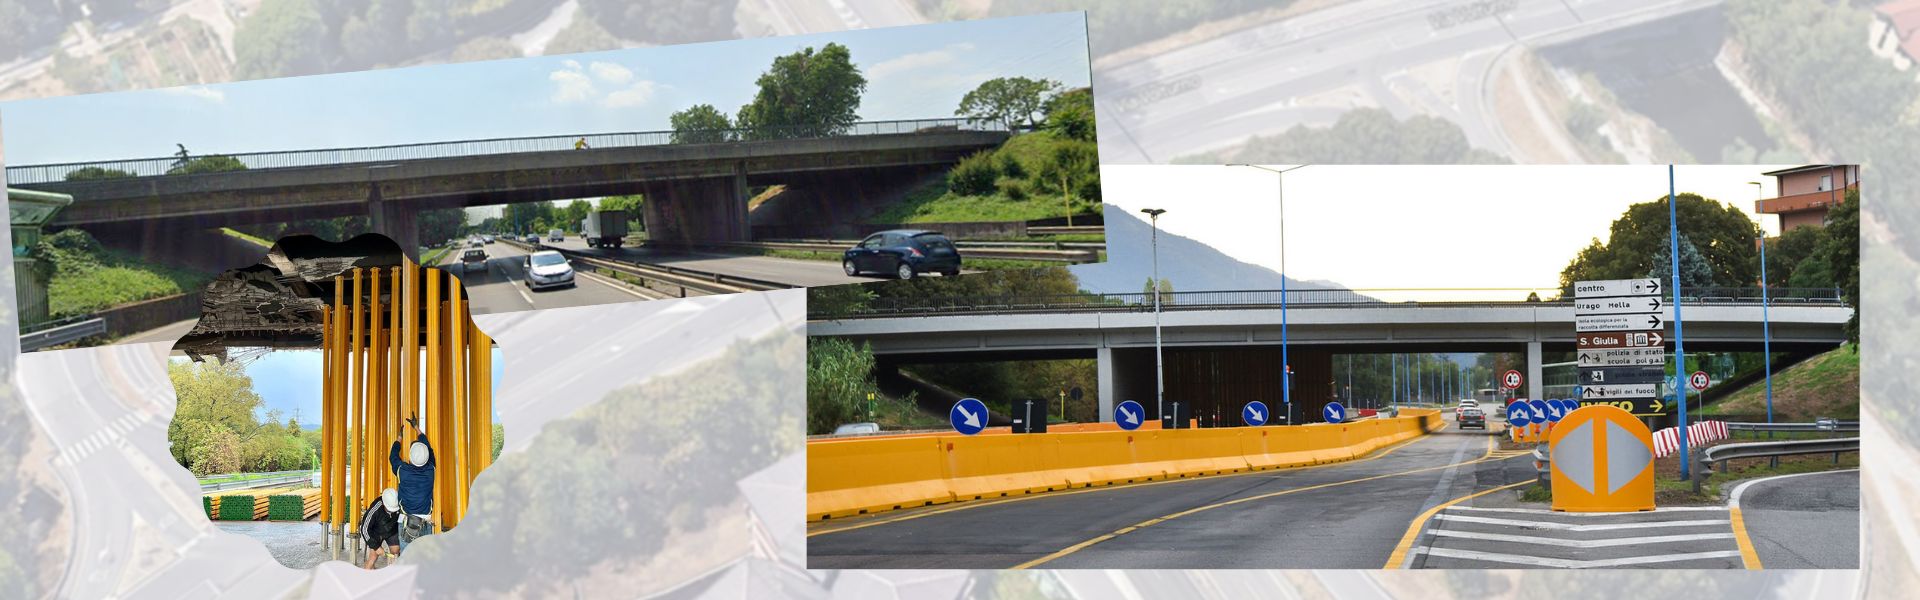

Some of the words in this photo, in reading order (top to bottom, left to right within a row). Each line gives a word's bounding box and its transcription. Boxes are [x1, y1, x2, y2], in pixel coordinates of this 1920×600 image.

[1608, 301, 1630, 309] Mella
[1580, 337, 1590, 345] S.
[1592, 336, 1619, 345] Giulia
[1606, 349, 1630, 357] polizia
[1606, 387, 1622, 395] vigili
